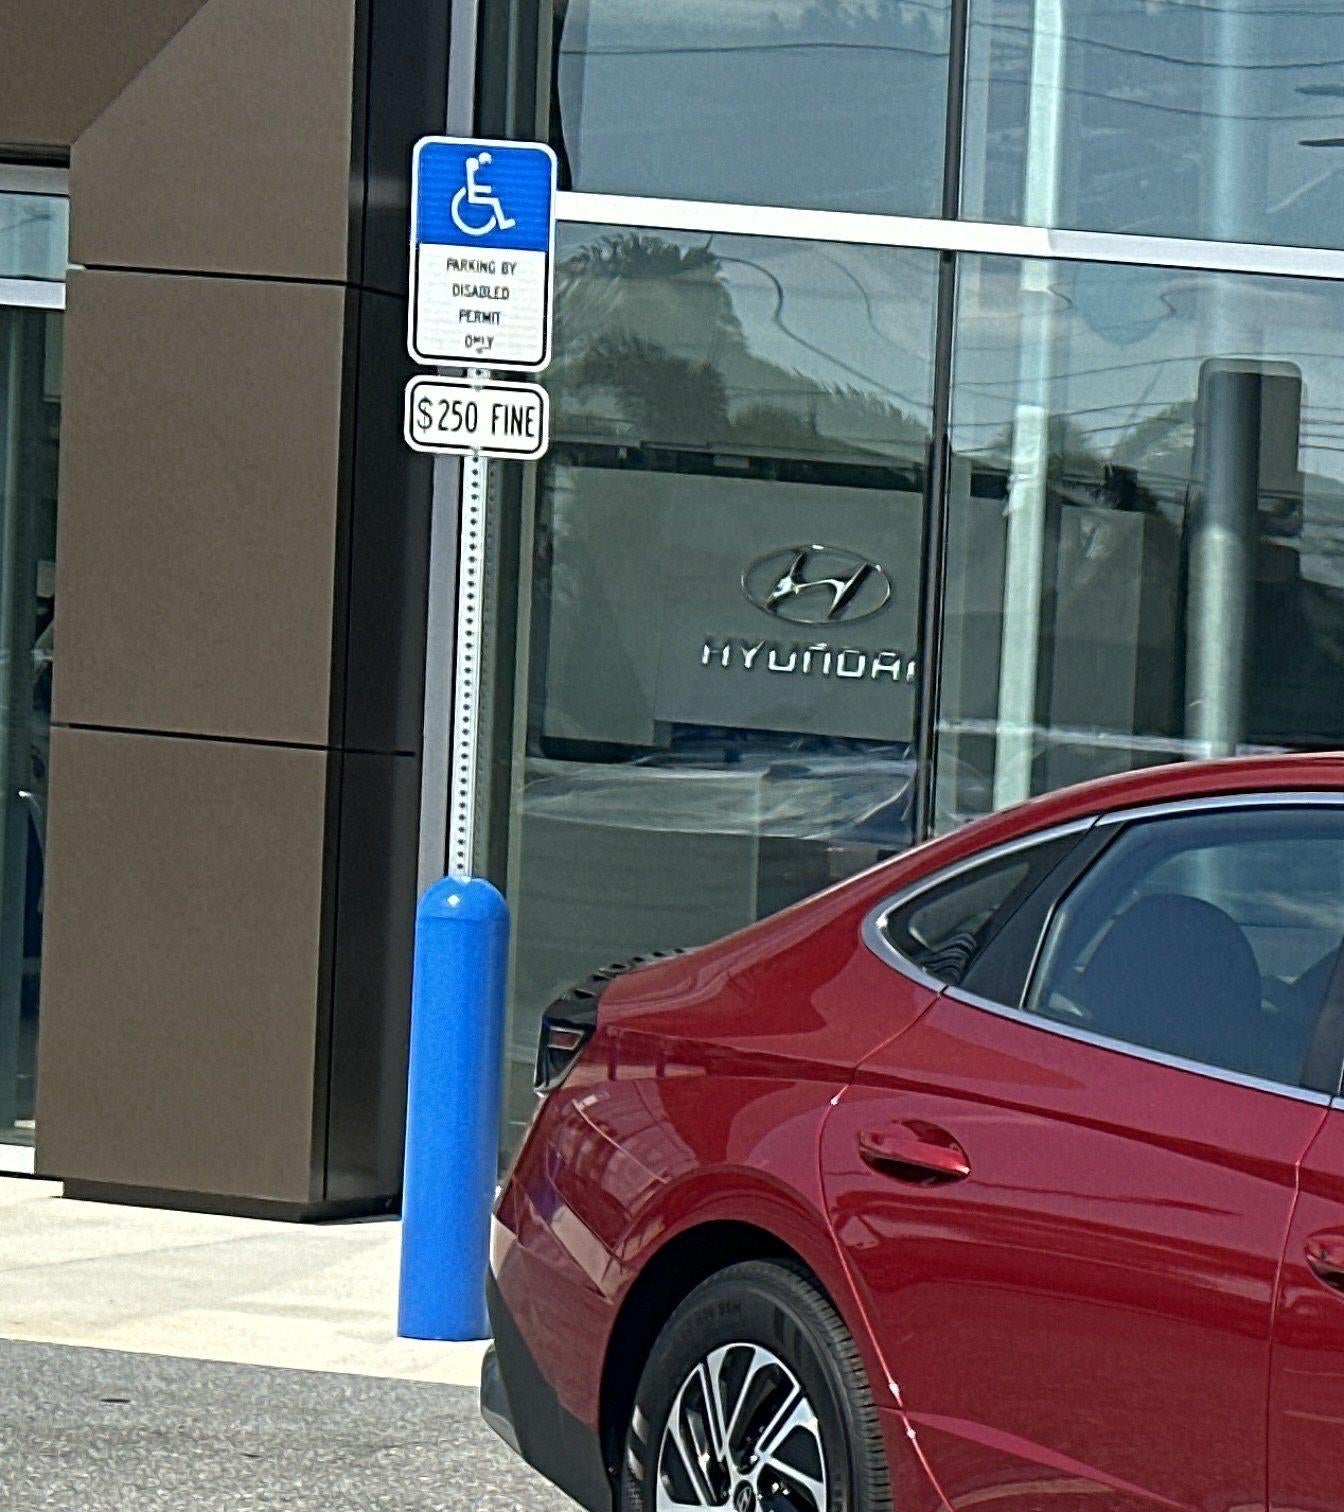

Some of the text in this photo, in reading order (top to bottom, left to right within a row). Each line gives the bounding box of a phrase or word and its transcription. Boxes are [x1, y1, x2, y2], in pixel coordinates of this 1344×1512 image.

[446, 257, 518, 277] PARKING BY
[452, 283, 511, 301] DISABLED
[458, 309, 501, 326] PERMIT
[464, 334, 495, 350] ONLY
[417, 397, 536, 438] $250 FINE
[702, 638, 916, 682] HYUNDAI
